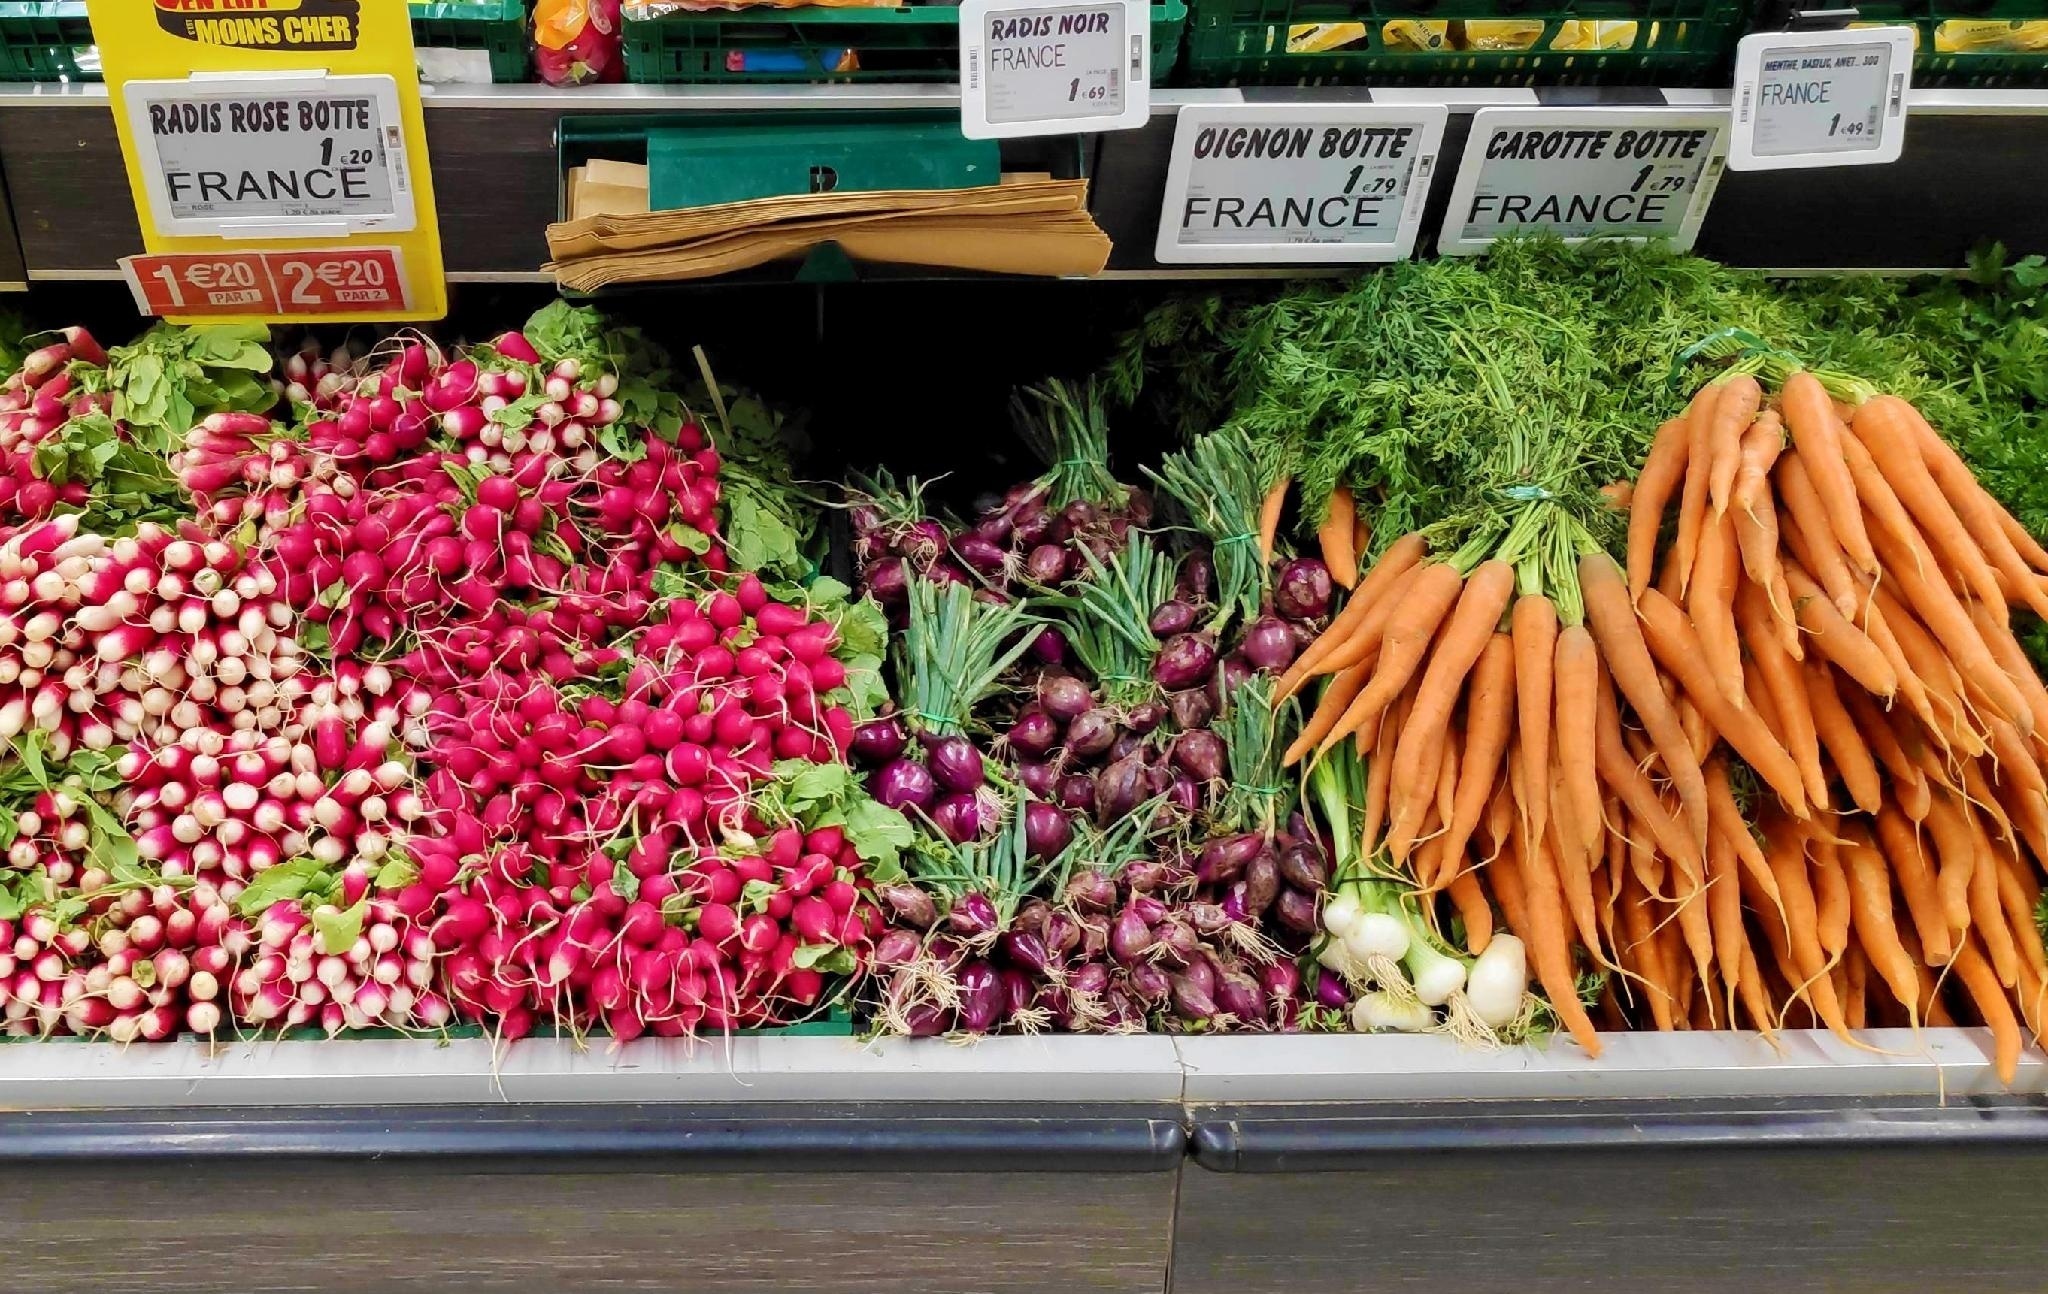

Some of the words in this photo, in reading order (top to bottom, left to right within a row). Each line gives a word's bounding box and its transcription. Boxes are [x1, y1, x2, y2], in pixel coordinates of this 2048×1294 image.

[195, 17, 280, 45] MOINS
[283, 16, 351, 43] CHER
[991, 16, 1053, 41] RADIS
[1058, 12, 1109, 35] NOIR
[991, 44, 1066, 71] FRANCE
[1761, 81, 1831, 106] FRANCE
[149, 102, 221, 135] RADIS
[229, 101, 289, 132] ROSE
[298, 100, 369, 131] BOTTE
[1194, 127, 1314, 159] OIGNON
[1318, 127, 1413, 159] BOTTE
[1485, 130, 1612, 160] CAROTTE
[1614, 129, 1707, 159] BOTTE
[166, 167, 371, 201] FRANCE
[1182, 197, 1383, 228] FRANCE
[1467, 194, 1670, 223] FRANCE
[214, 292, 241, 304] PAR
[247, 292, 255, 302] 1
[341, 291, 370, 301] PAR
[373, 290, 382, 300] 2
